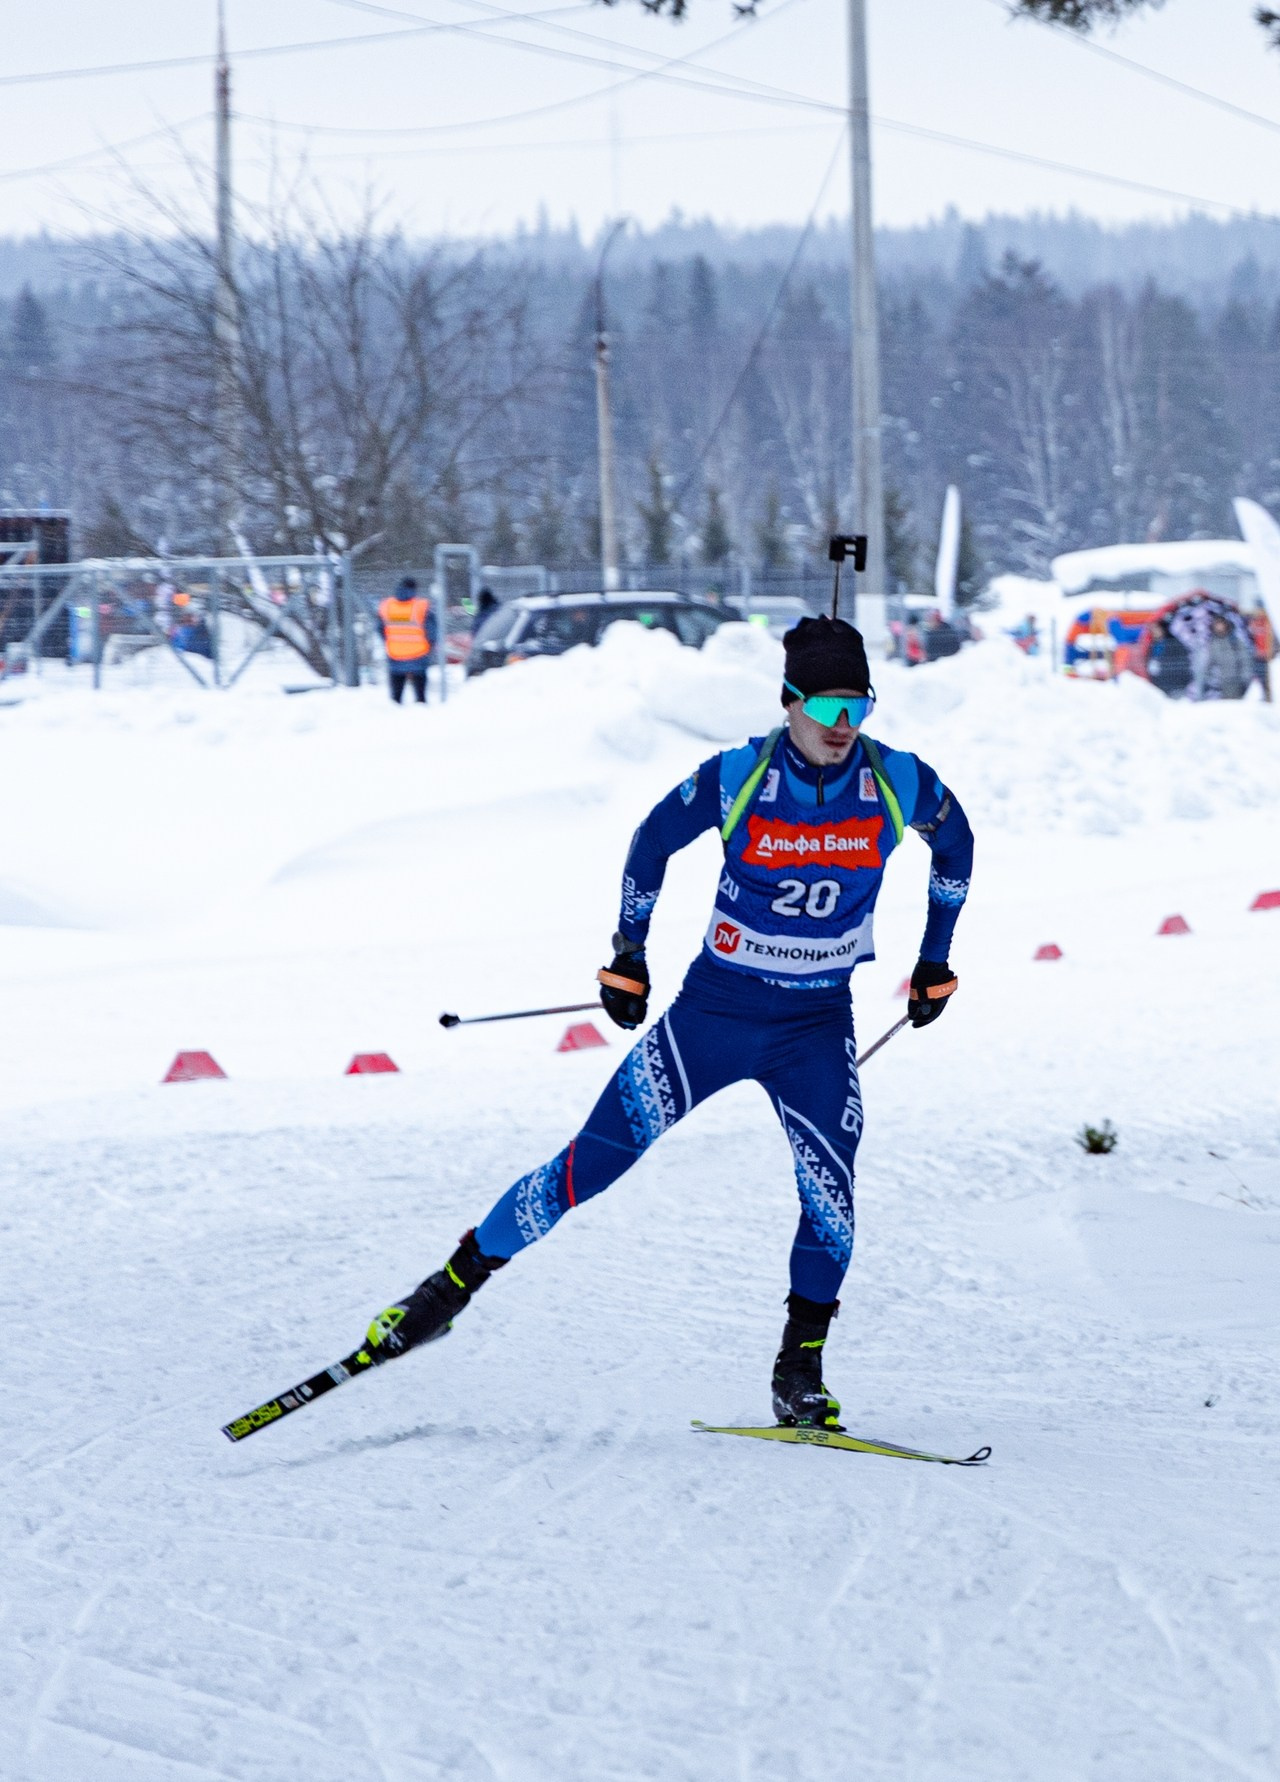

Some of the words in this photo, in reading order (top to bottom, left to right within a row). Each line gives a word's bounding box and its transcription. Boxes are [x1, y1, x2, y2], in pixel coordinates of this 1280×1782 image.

[756, 833, 820, 857] Альфа
[824, 834, 870, 852] Банк
[771, 879, 841, 919] 20
[744, 938, 858, 962] ТЕХНОНИОЛ
[795, 1429, 830, 1443] FISCHER
